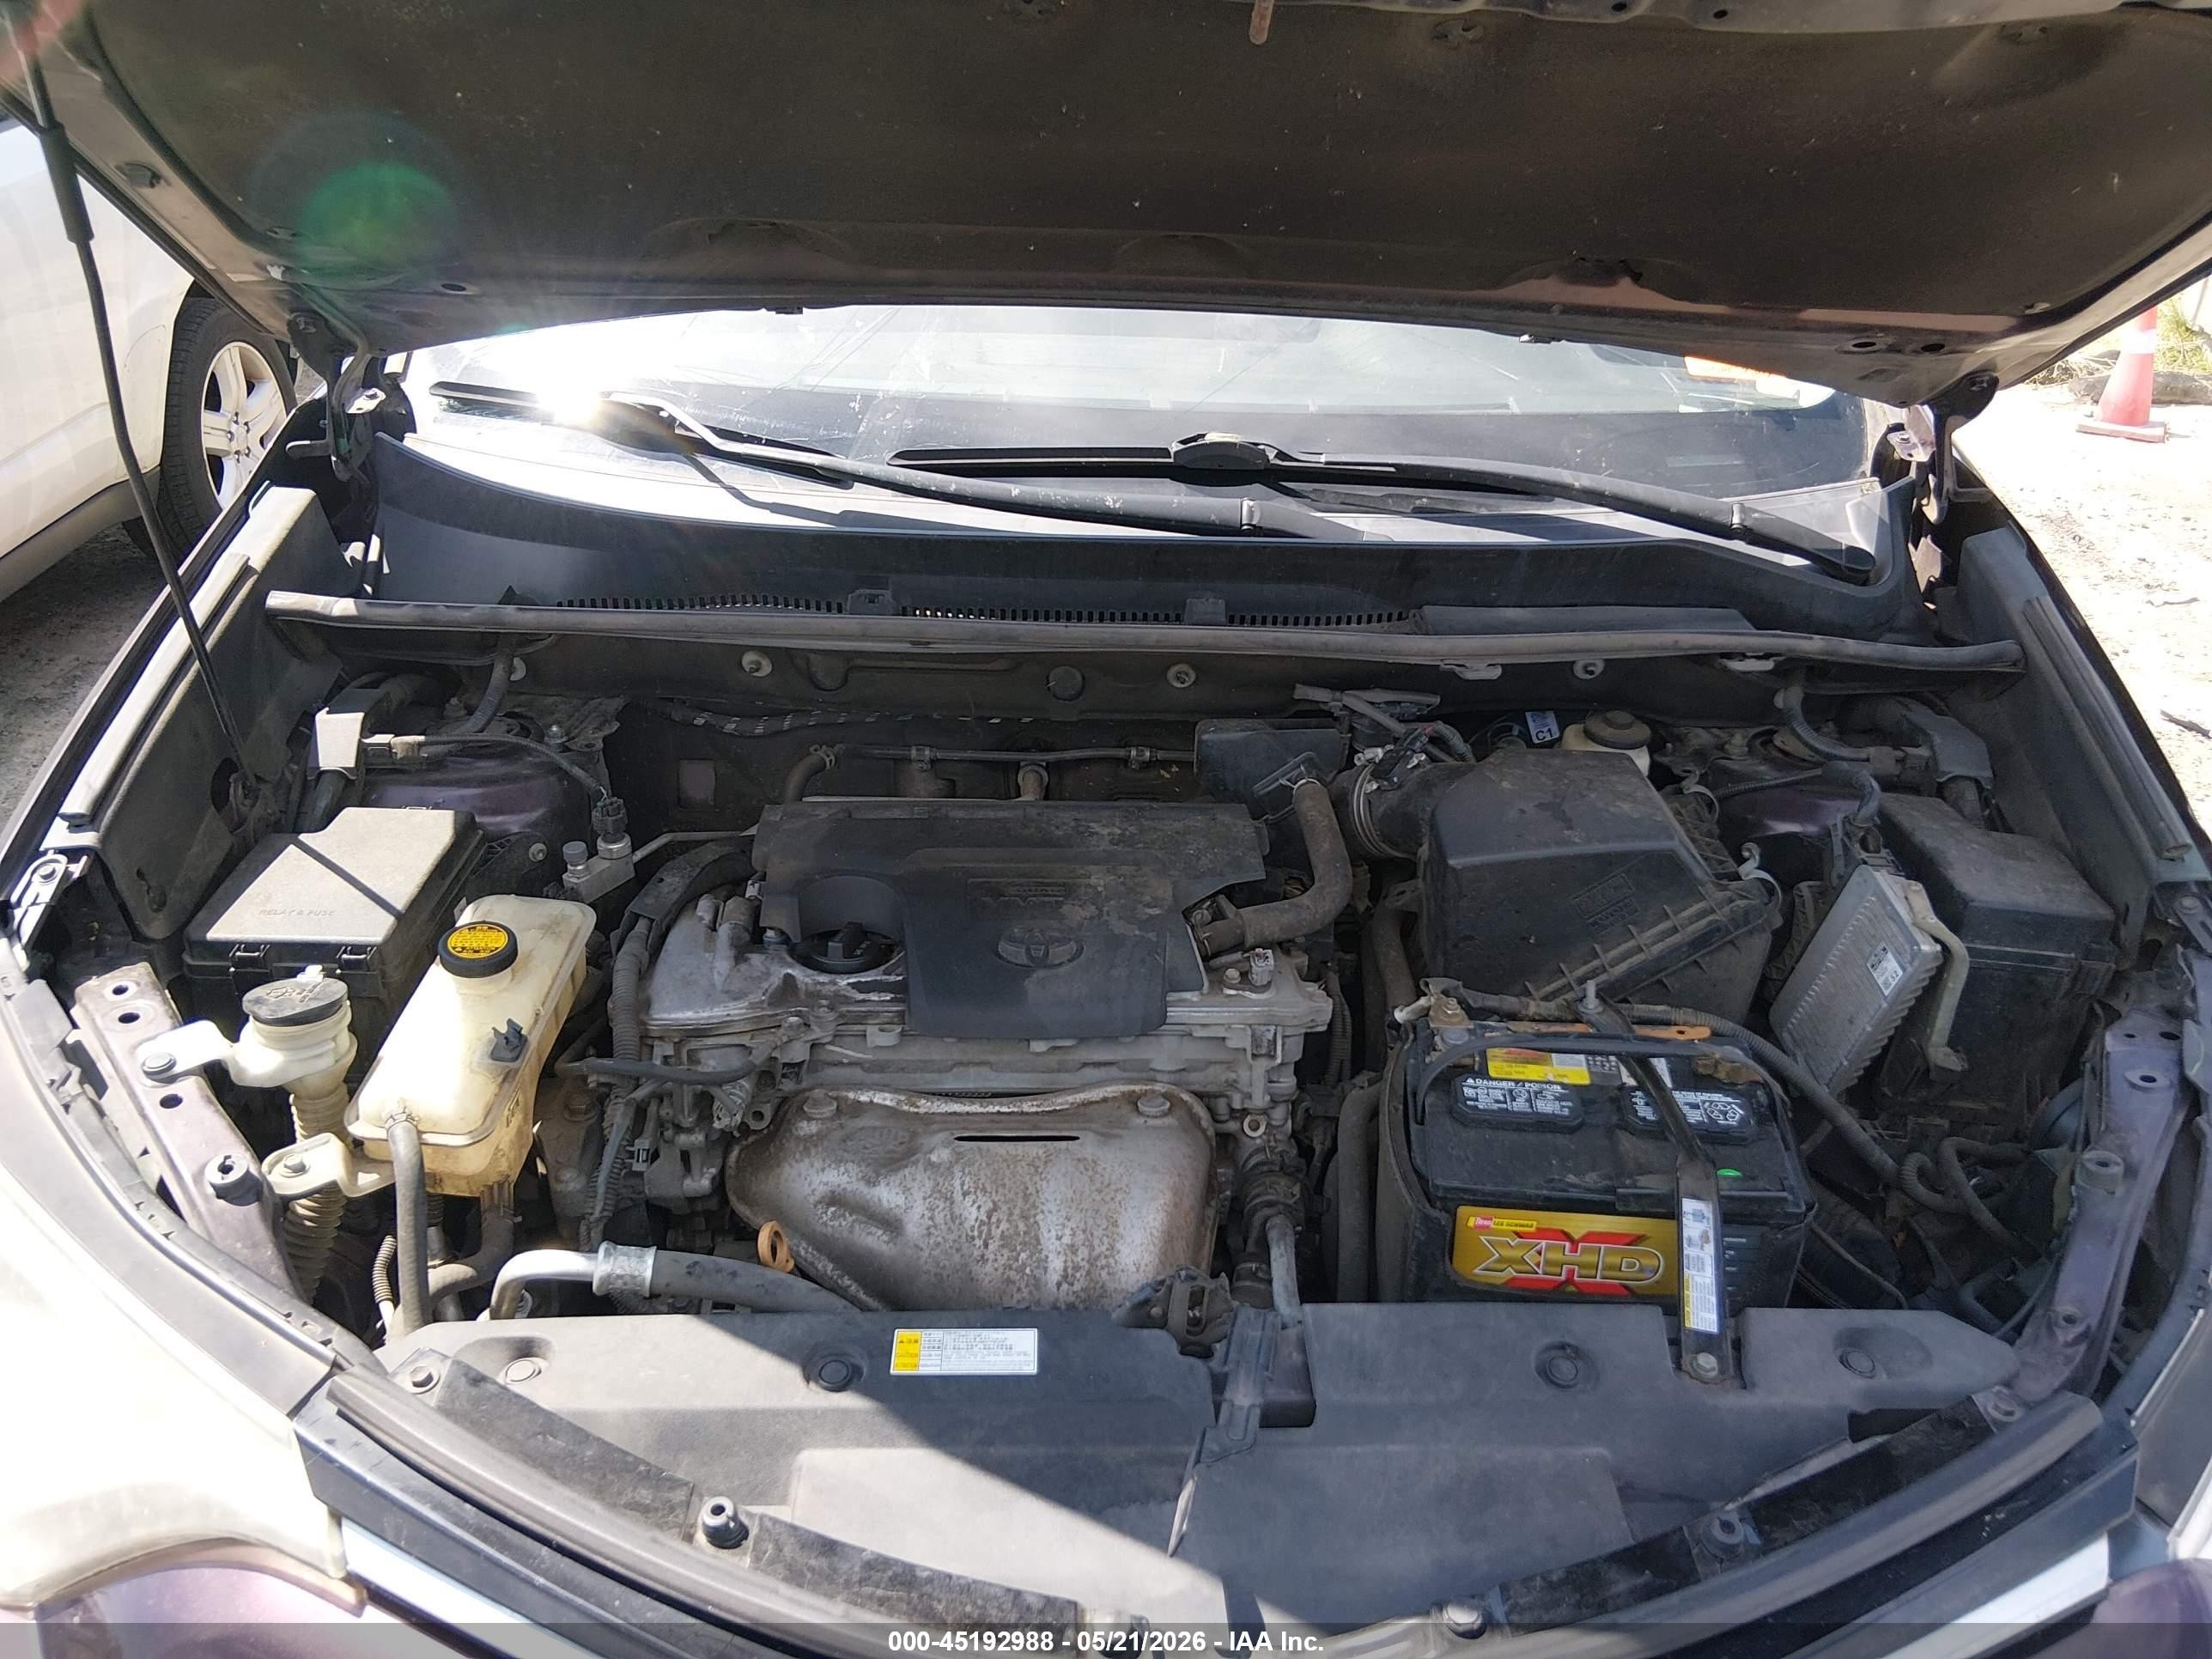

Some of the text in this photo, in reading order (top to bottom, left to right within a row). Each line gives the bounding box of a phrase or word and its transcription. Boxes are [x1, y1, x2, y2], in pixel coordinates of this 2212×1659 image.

[1535, 727, 1554, 741] C1
[258, 908, 296, 917] RELAY
[307, 908, 337, 917] FUSE
[1475, 1078, 1516, 1087] DANGER
[1524, 1082, 1562, 1091] POISON
[1473, 1236, 1664, 1284] XHD
